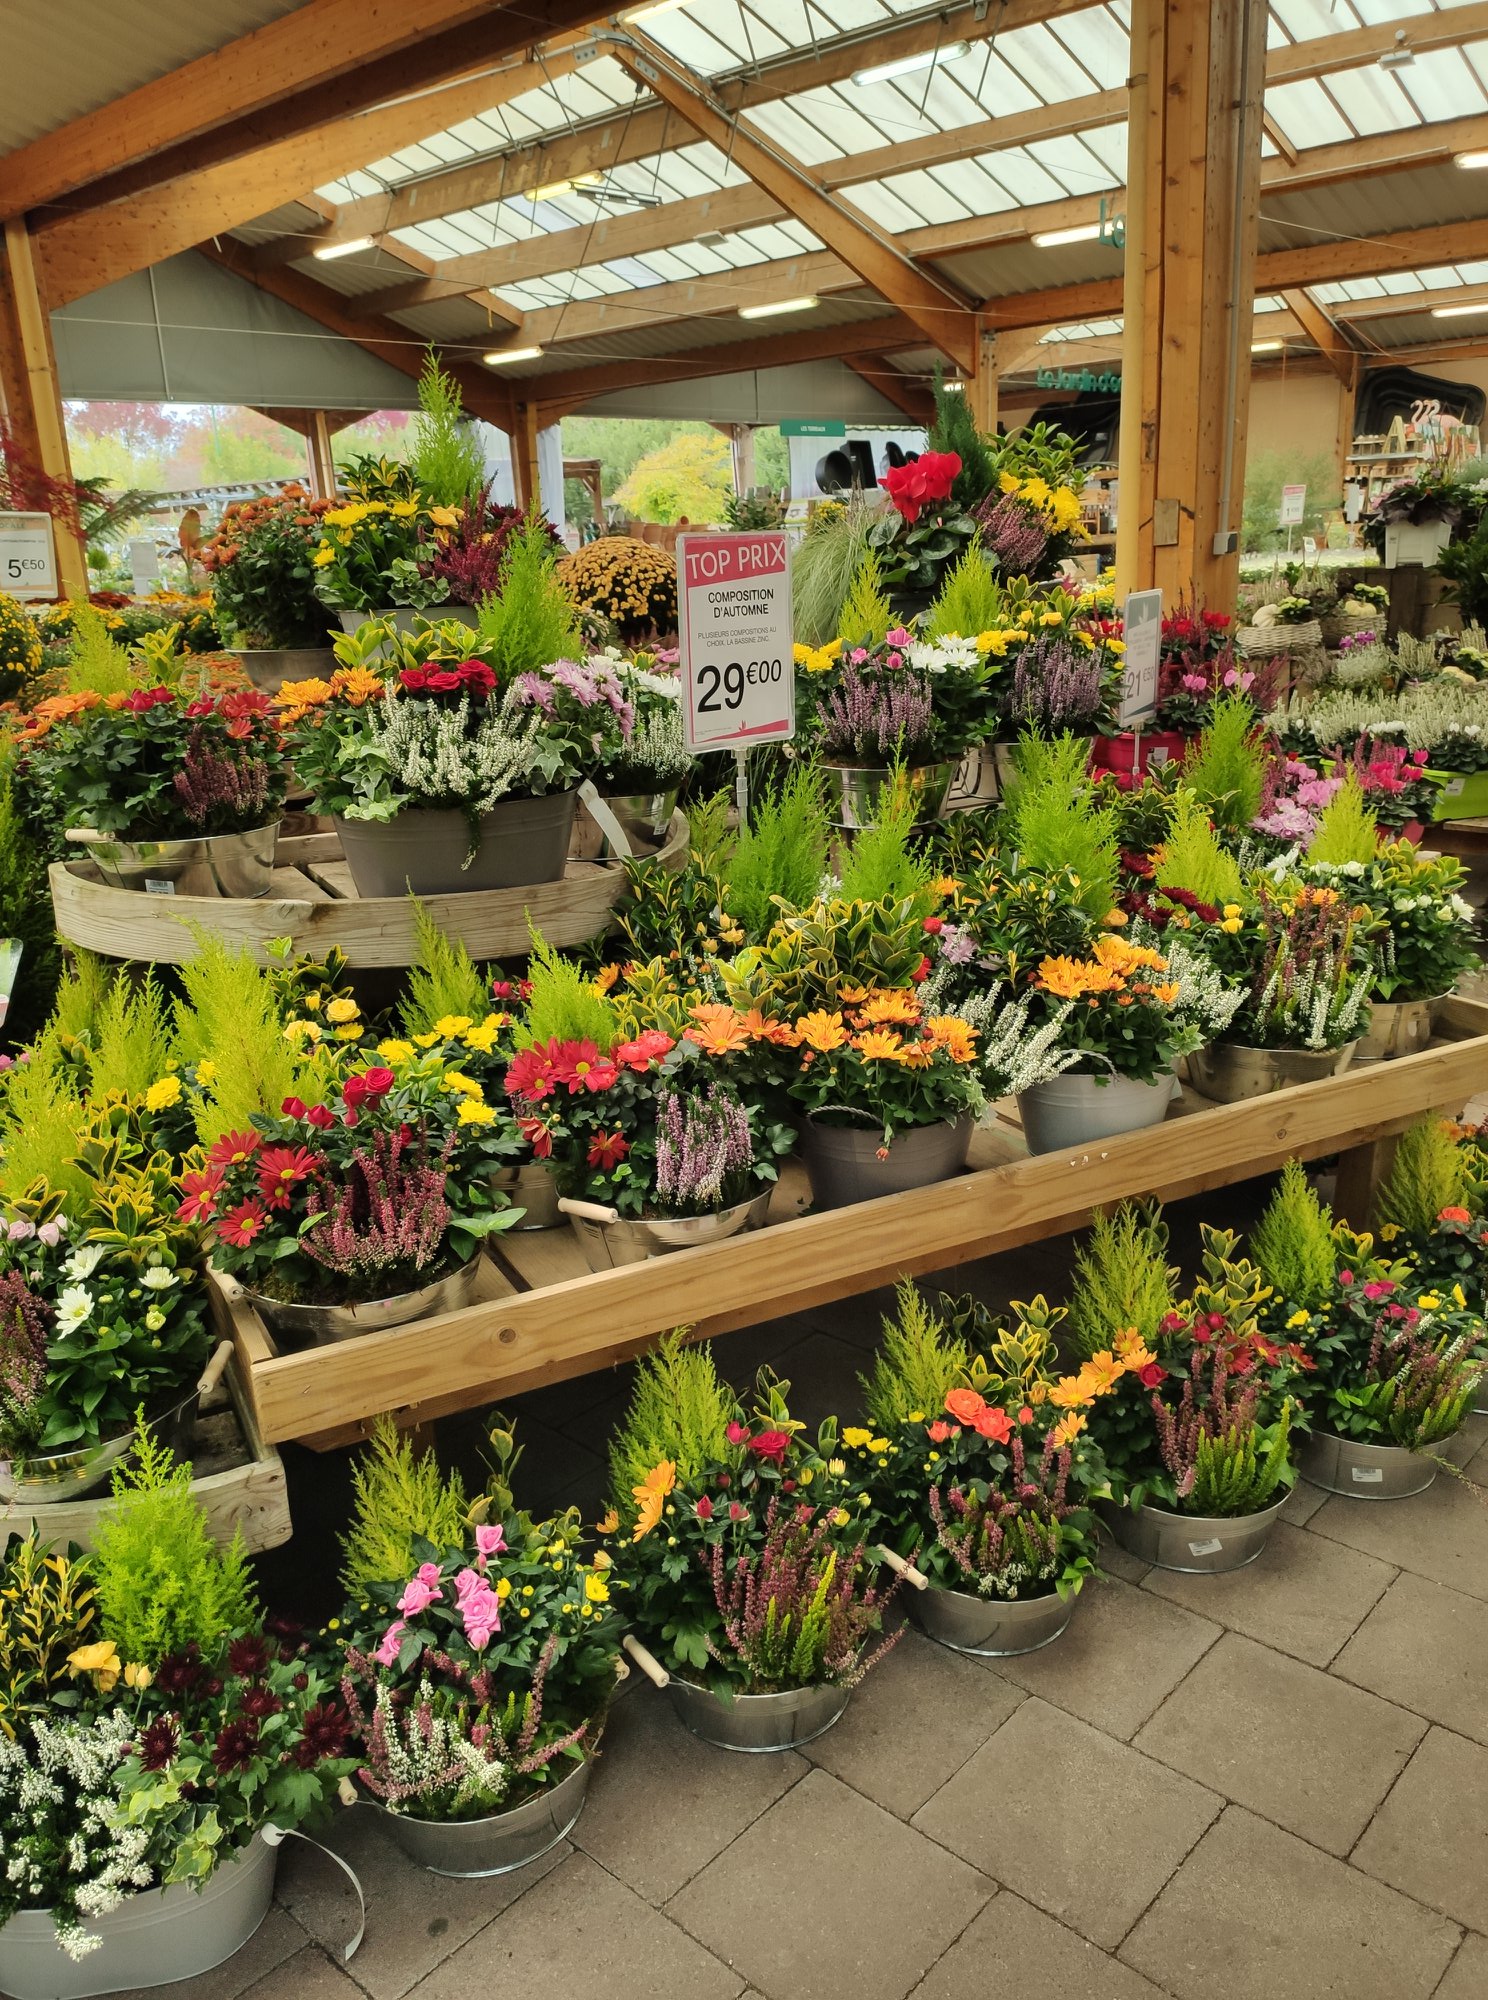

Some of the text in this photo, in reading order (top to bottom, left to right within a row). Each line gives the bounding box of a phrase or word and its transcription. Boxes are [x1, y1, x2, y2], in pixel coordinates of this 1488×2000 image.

[686, 540, 786, 579] TOP PRIX
[8, 559, 45, 578] 5€50
[708, 588, 774, 604] COMPOSITION
[713, 603, 769, 618] D'AUTOMNE
[697, 630, 729, 640] PLUSIEURS
[730, 626, 769, 637] COMPOSITIONS
[727, 638, 734, 646] LA
[734, 636, 756, 645] BASSINE
[697, 658, 782, 713] 29€00
